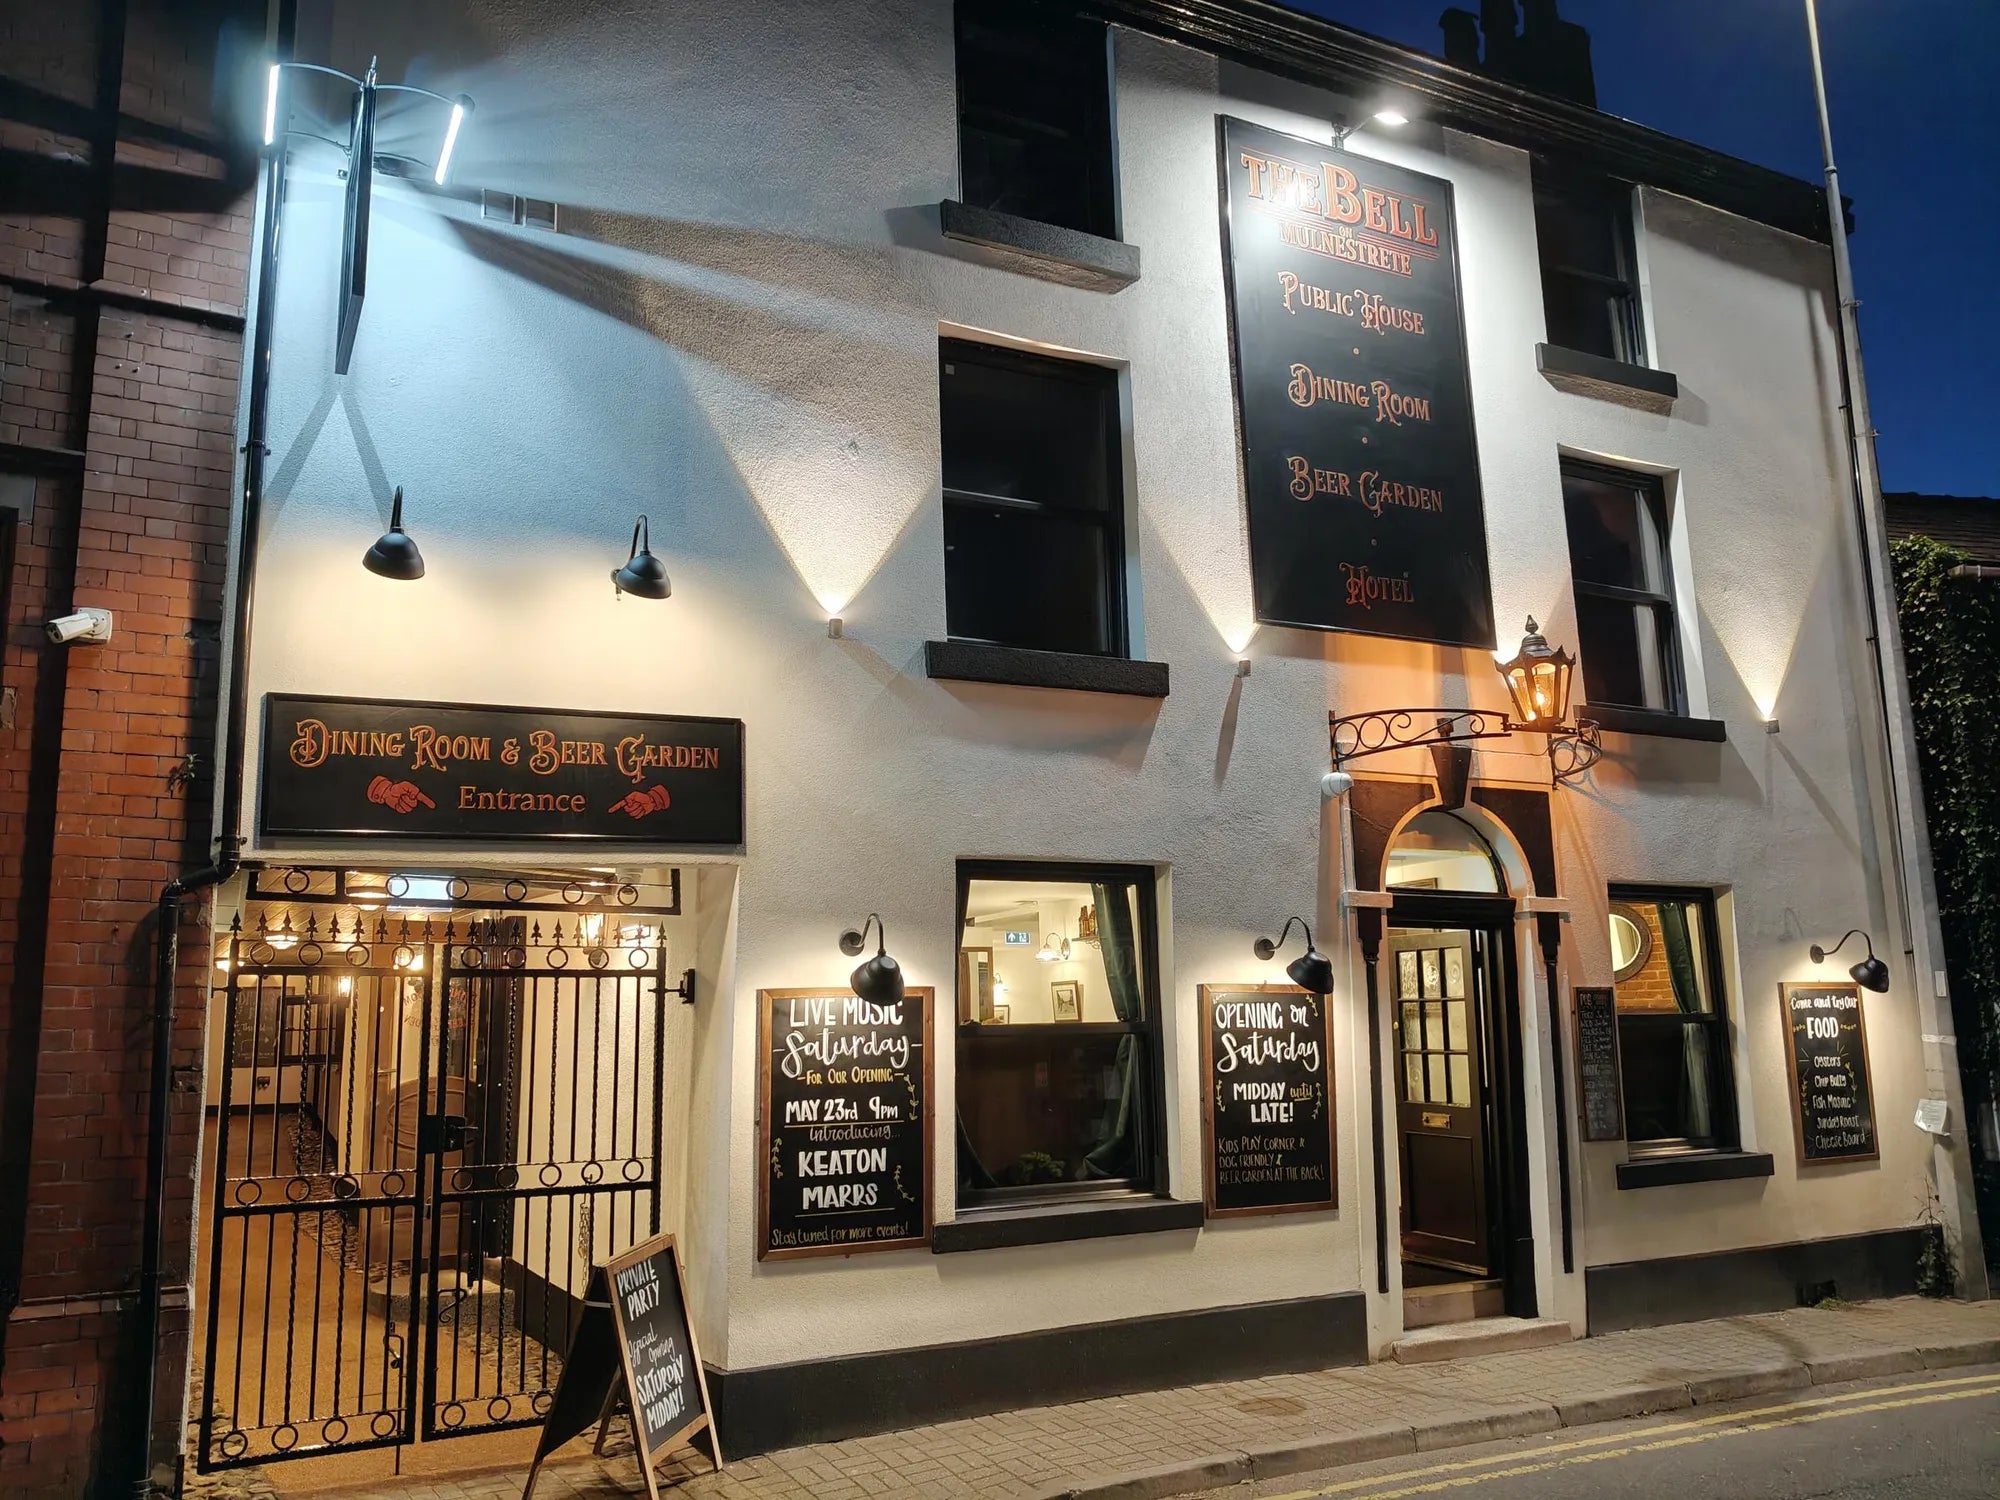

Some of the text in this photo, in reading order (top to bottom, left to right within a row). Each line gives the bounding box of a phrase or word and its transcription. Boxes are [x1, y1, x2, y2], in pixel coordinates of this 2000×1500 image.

[1321, 162, 1438, 248] BELL
[1279, 222, 1412, 275] MULNESTRETE
[1278, 270, 1424, 335] PUBLIC HOUSE
[1287, 363, 1431, 426] DINING ROOM
[1287, 456, 1442, 518] BEER GARDEN
[1339, 562, 1415, 610] HOTEL
[290, 719, 719, 783] DINING ROOM & BEER GARDEN
[459, 786, 586, 813] Entrance
[790, 997, 903, 1027] LIVE MUSIC
[1215, 1002, 1309, 1029] OPENING on
[1813, 995, 1831, 1008] and
[1806, 1017, 1839, 1039] FOOD
[781, 1028, 909, 1078] Saturday
[1217, 1032, 1319, 1072] Saturday
[1233, 1082, 1313, 1101] MIDDAY until
[785, 1099, 820, 1123] MAY
[823, 1098, 858, 1121] 23rd
[1251, 1103, 1294, 1123] LATE!
[1219, 1137, 1239, 1153] KIDS
[1241, 1135, 1261, 1150] PLAY
[1264, 1138, 1296, 1150] CORNER
[1219, 1156, 1237, 1168] DOG
[1240, 1153, 1274, 1167] FRIENDLY
[798, 1147, 887, 1178] KEATON
[803, 1183, 878, 1210] MARRS
[772, 1229, 797, 1245] Stay
[849, 1226, 872, 1240] more
[617, 1257, 657, 1297] PRIVATE
[627, 1280, 659, 1321] PARTY
[636, 1354, 684, 1405] SATURDAY
[646, 1385, 685, 1434] MIDDAY!
